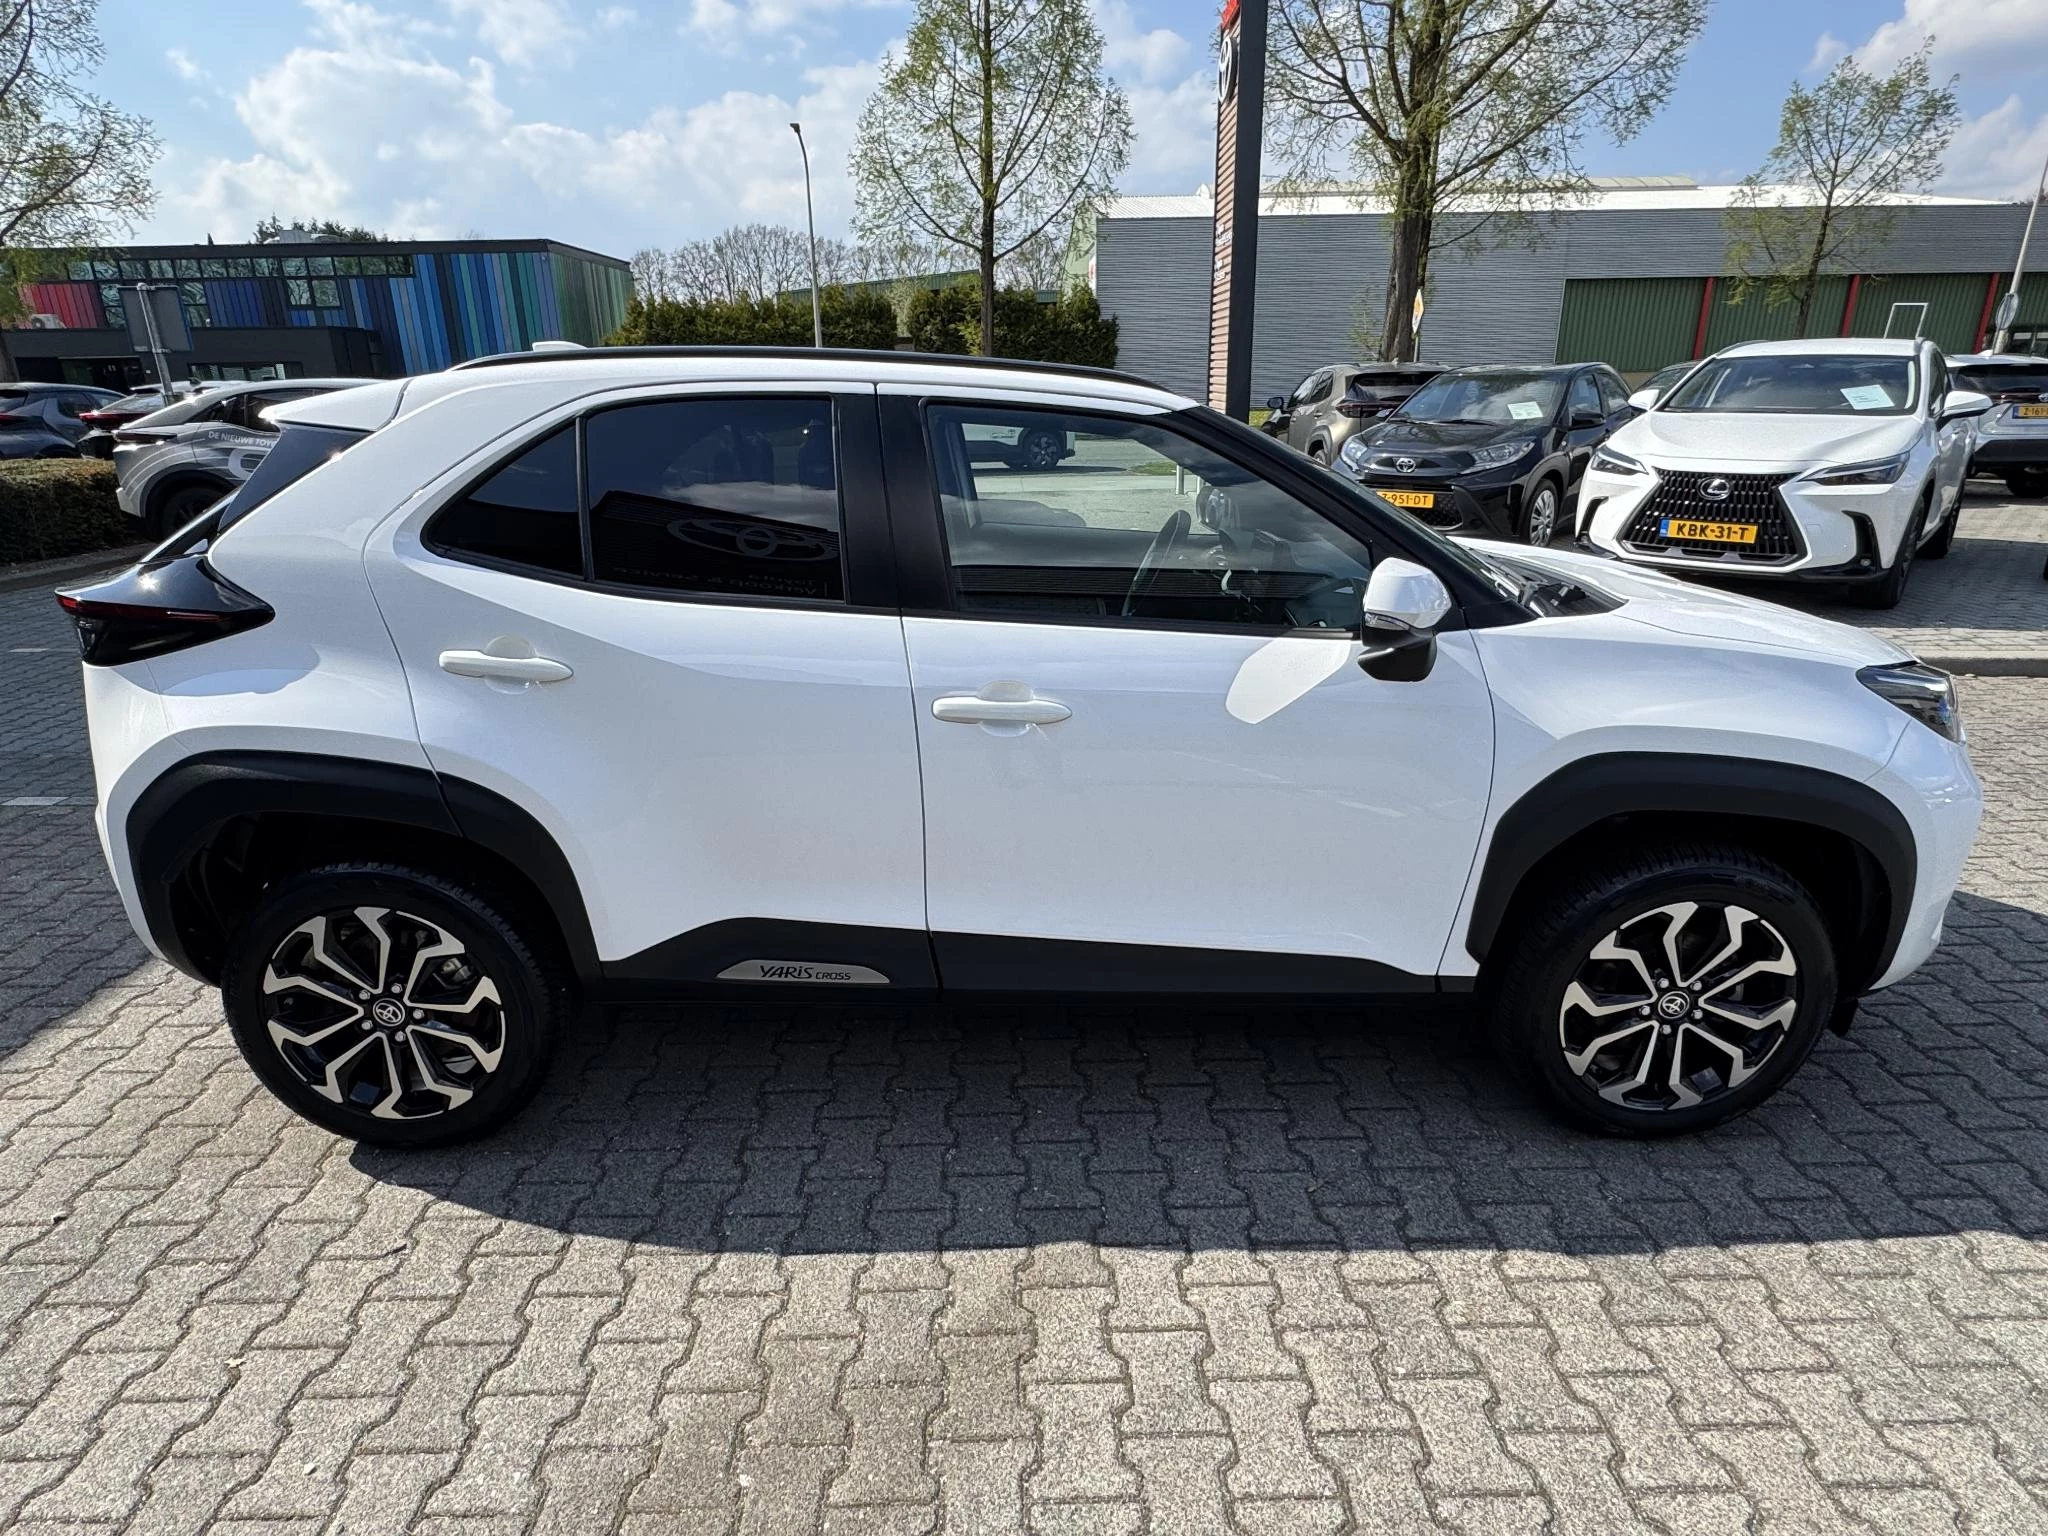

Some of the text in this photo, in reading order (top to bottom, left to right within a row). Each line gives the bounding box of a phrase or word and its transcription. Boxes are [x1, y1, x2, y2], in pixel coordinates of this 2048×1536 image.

[208, 431, 220, 440] DE
[221, 433, 253, 443] NIEUWE
[1676, 522, 1749, 540] KBK-31-T
[815, 971, 851, 981] CROSS
